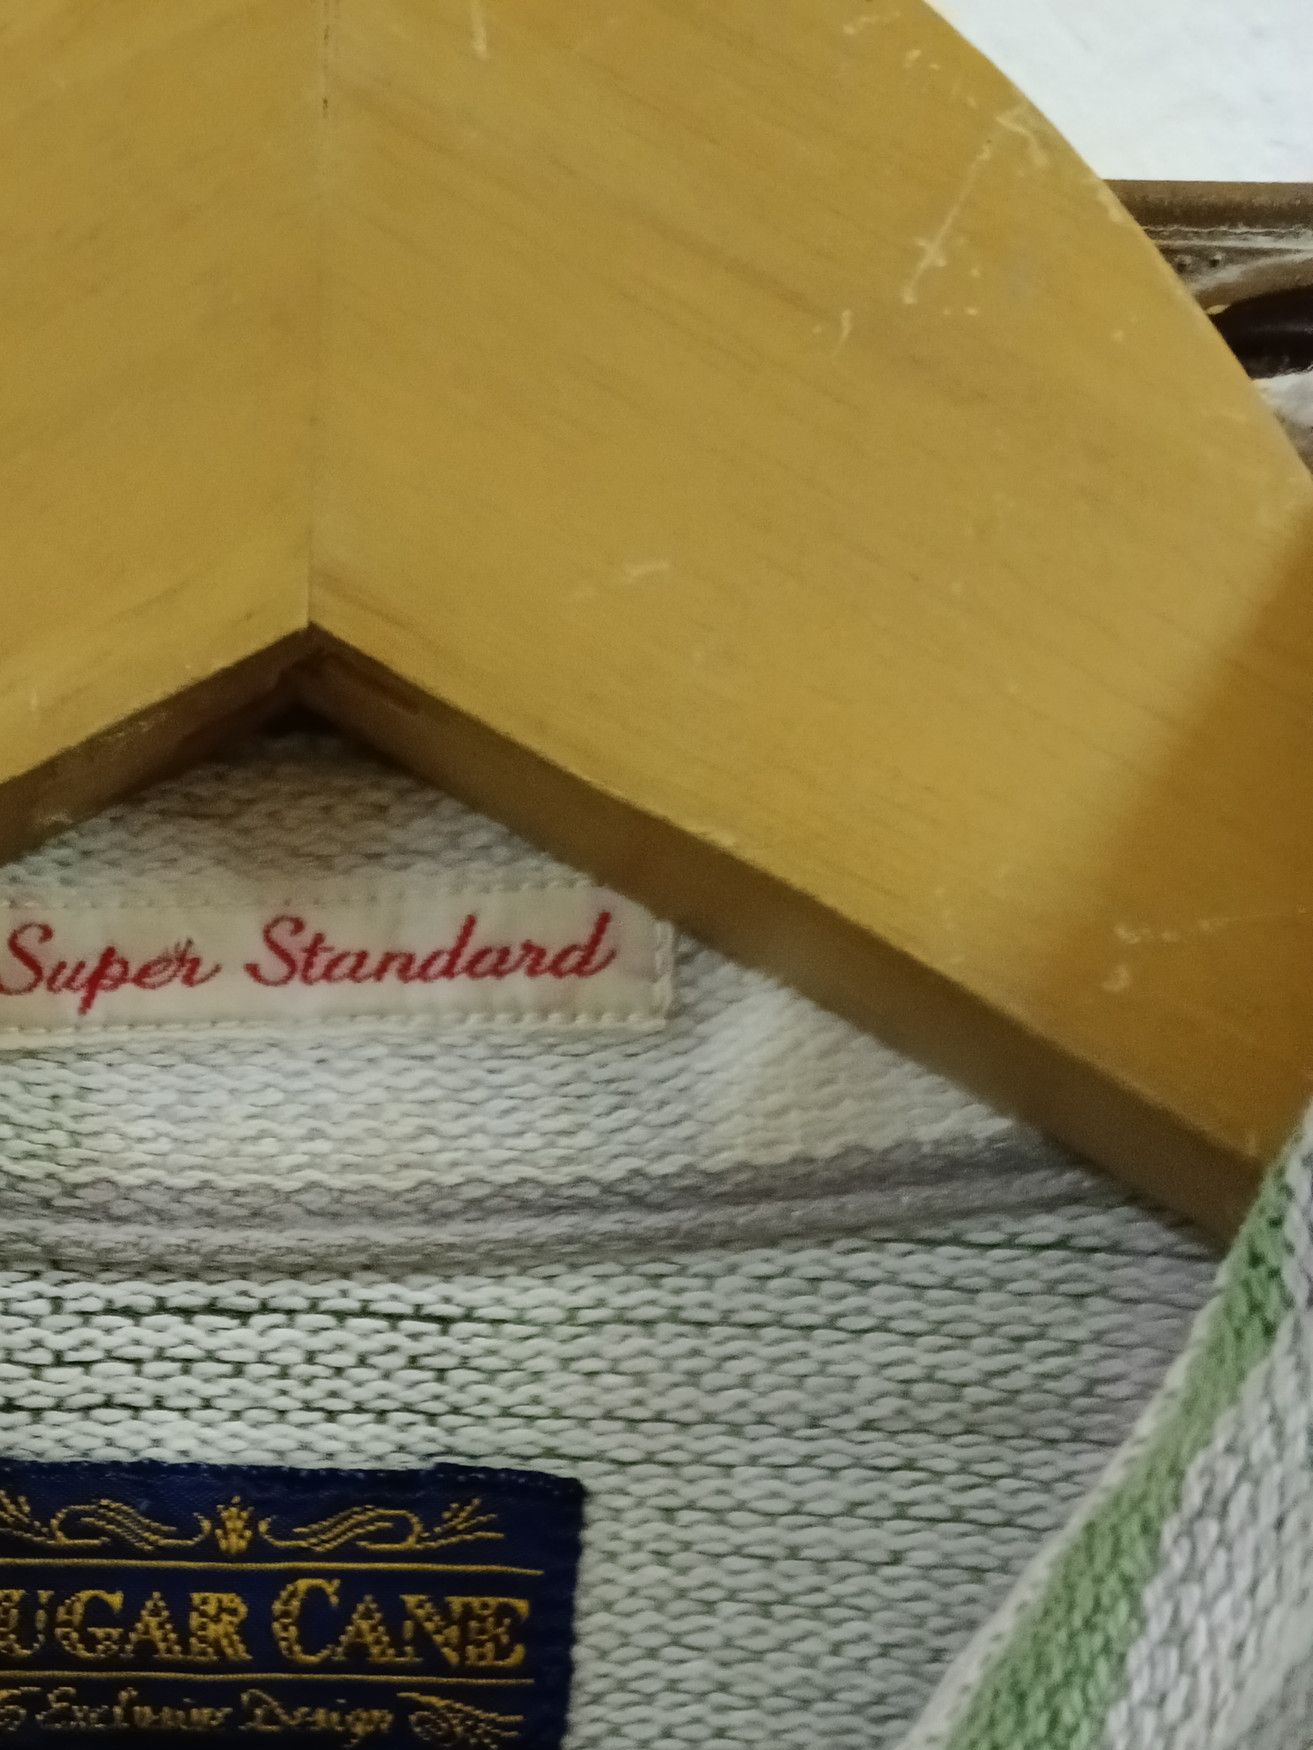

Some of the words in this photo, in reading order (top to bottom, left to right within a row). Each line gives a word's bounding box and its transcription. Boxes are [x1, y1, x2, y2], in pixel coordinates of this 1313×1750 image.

[245, 912, 618, 986] Standard
[271, 1578, 530, 1667] CANE
[238, 1688, 394, 1748] Design
